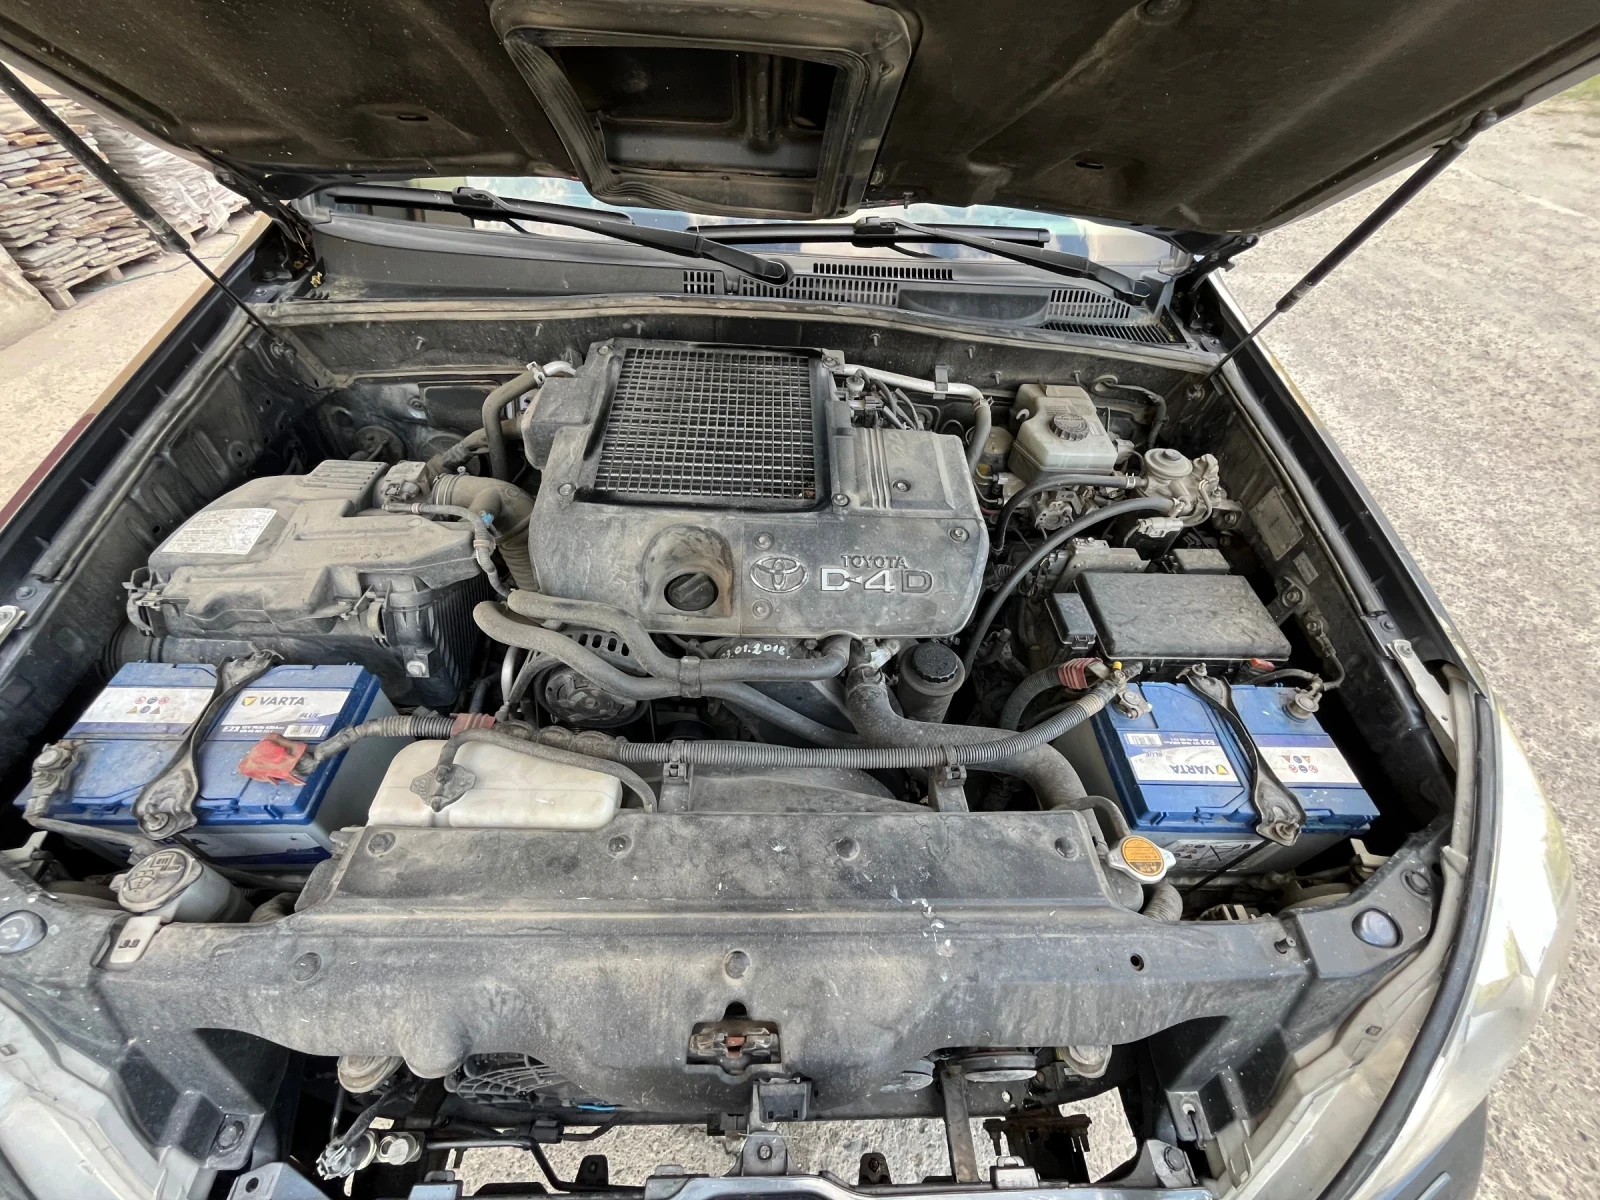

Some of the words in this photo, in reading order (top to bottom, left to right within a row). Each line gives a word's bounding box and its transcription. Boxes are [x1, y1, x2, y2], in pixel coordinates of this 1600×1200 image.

[840, 555, 908, 569] TOYOTA
[820, 568, 933, 593] D-4D
[260, 697, 305, 706] VARTA
[1170, 764, 1215, 775] VARTA
